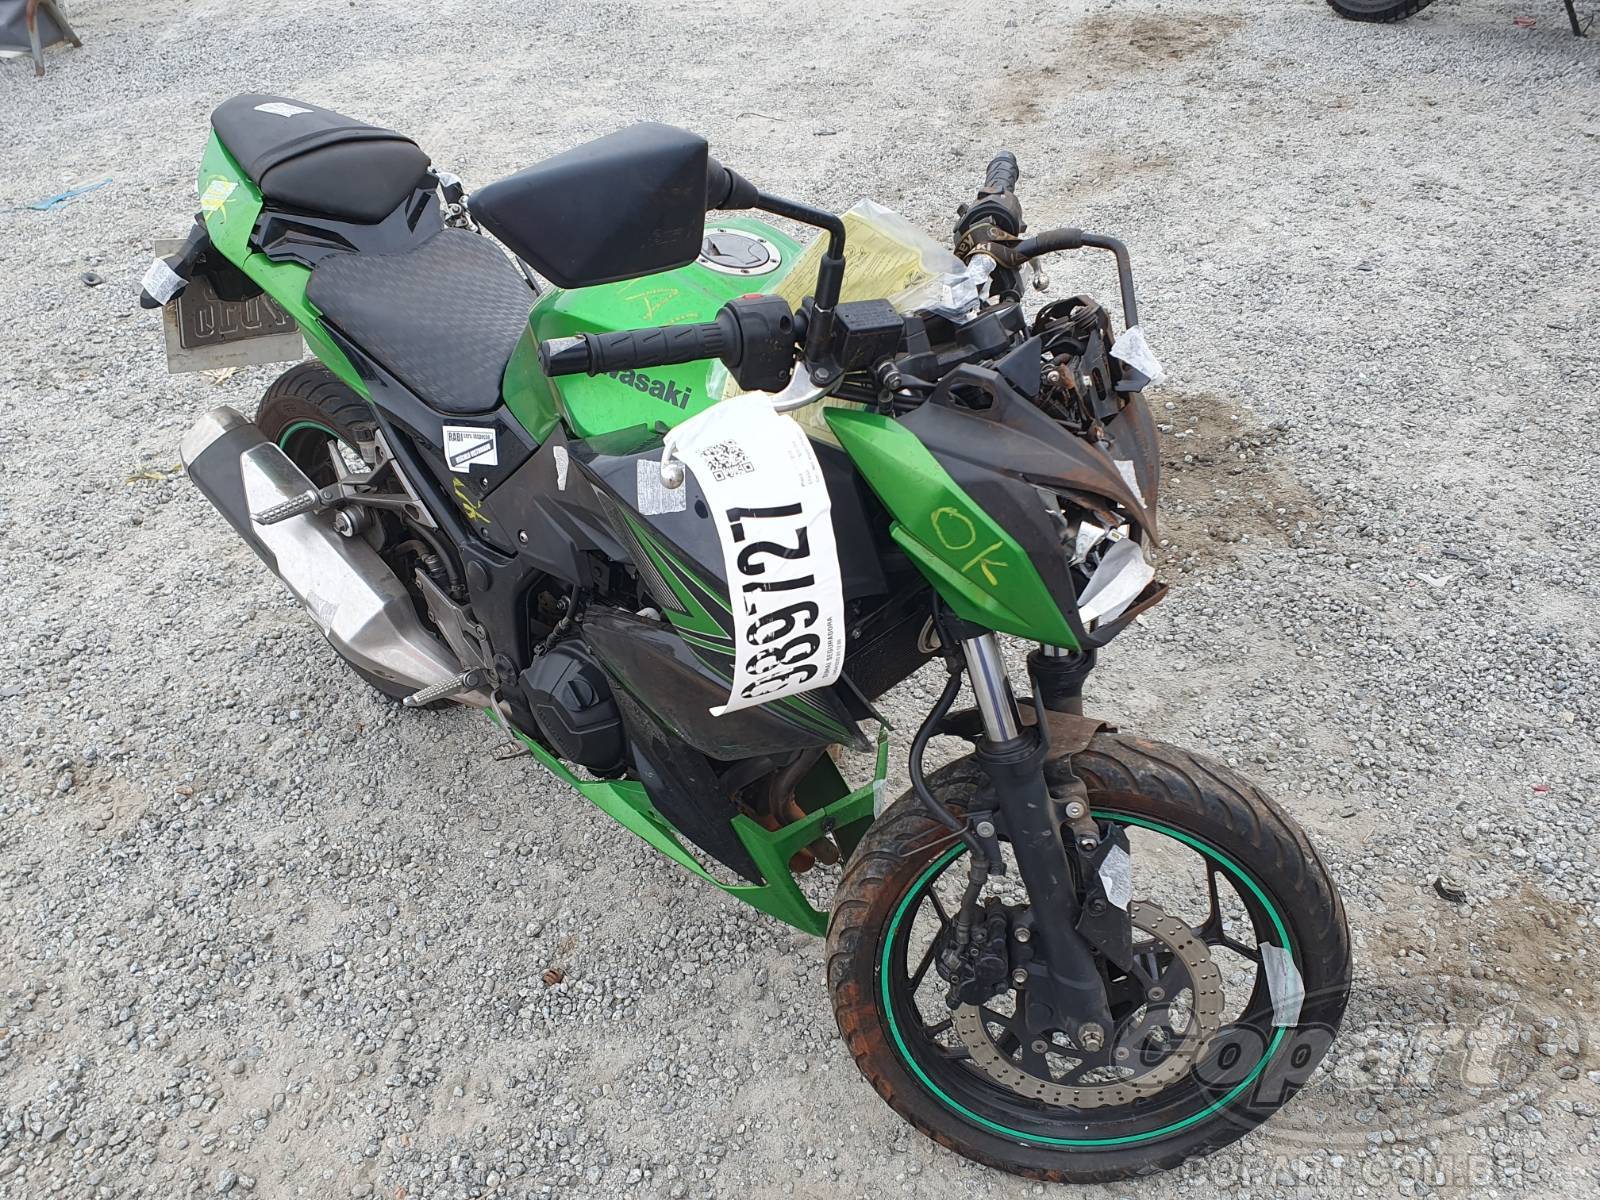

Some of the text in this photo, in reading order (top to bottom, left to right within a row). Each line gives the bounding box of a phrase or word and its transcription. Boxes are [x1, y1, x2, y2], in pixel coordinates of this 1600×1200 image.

[607, 367, 692, 410] asaki
[930, 507, 1008, 586] OK
[726, 502, 820, 698] 989727
